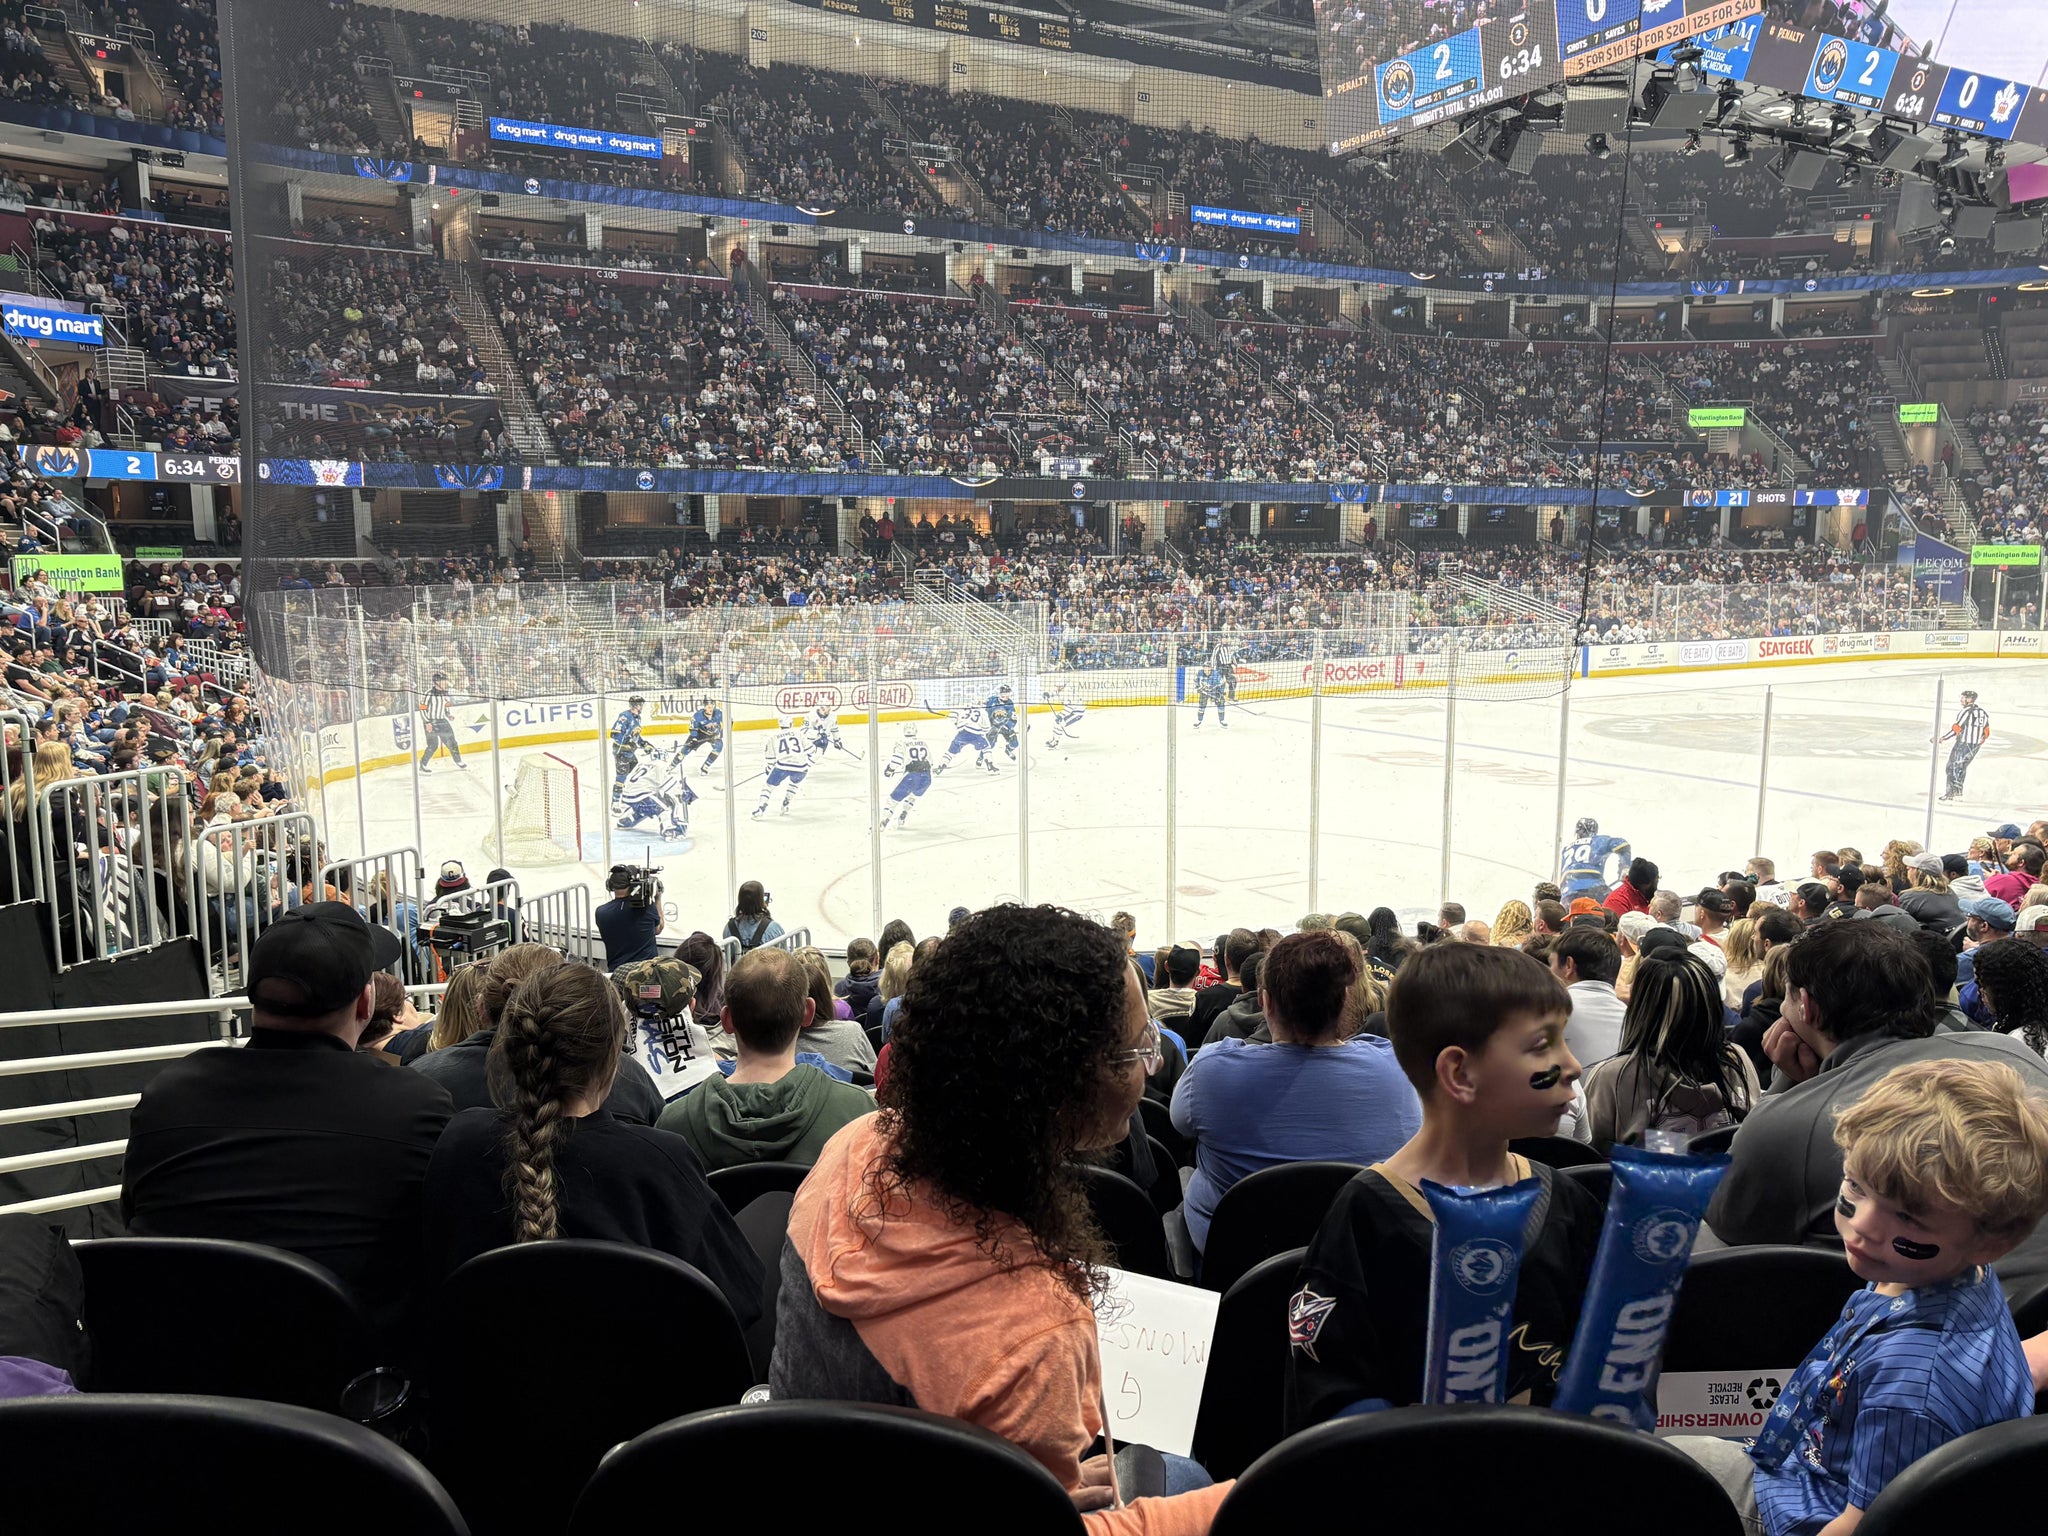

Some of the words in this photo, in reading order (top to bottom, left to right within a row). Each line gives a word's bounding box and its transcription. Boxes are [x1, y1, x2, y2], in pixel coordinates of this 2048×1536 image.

[752, 30, 767, 41] 209
[1566, 39, 1588, 55] SHOTS
[1593, 34, 1600, 44] 7
[1604, 24, 1626, 40] SAVES
[1628, 20, 1639, 32] 19
[1578, 58, 1584, 70] 5
[1587, 51, 1605, 67] FOR
[1606, 46, 1624, 62] $10
[1644, 31, 1664, 47] FOR
[1666, 22, 1686, 39] $20
[1692, 14, 1711, 31] 125
[1712, 7, 1732, 23] FOR
[1777, 27, 1805, 44] PENALTY
[78, 36, 96, 47] 206
[105, 41, 122, 52] 207
[953, 63, 967, 74] 210
[1432, 43, 1453, 80] 2
[1499, 43, 1543, 80] 6:34
[1858, 50, 1880, 86] 2
[399, 79, 414, 89] 207
[446, 86, 461, 95] 208
[1336, 74, 1369, 95] PENALTY
[1958, 74, 1979, 109] 0
[1413, 95, 1432, 108] SHOTS
[1432, 91, 1442, 103] 21
[1469, 79, 1476, 89] 7
[1849, 92, 1857, 102] 21
[1875, 98, 1880, 107] 7
[1411, 105, 1444, 126] TONIGHT'S
[1444, 101, 1466, 117] TOTAL
[1468, 85, 1504, 108] $14,001
[1895, 92, 1925, 116] 6:34
[694, 120, 707, 129] 209
[1954, 115, 1960, 124] 7
[496, 123, 522, 138] drug
[522, 127, 547, 139] mart
[554, 130, 578, 144] drug
[578, 134, 603, 146] mart
[1360, 126, 1387, 143] RAFFLE
[609, 137, 632, 152] drug
[633, 140, 656, 153] mart
[1195, 209, 1211, 220] drug
[1211, 212, 1227, 221] mart
[1231, 213, 1246, 224] drug
[1246, 215, 1262, 224] mart
[1265, 218, 1281, 229] drug
[1281, 221, 1296, 229] mart
[4, 309, 53, 336] drug
[55, 318, 103, 337] mart
[278, 401, 339, 422] THE
[127, 456, 141, 474] 2
[164, 459, 205, 477] 6:34
[208, 456, 238, 466] PERIOD
[221, 465, 231, 476] 2
[1728, 492, 1742, 505] 21
[1757, 493, 1785, 503] SHOTS
[1805, 492, 1814, 505] 7
[1983, 551, 2020, 560] Huntington
[2021, 551, 2038, 559] Bank
[95, 567, 121, 578] Bank
[1758, 638, 1815, 658] SEATGEEK
[1839, 638, 1856, 650] drug
[1856, 638, 1873, 647] mart
[1324, 661, 1386, 682] Rocket
[1078, 680, 1122, 690] MEDICAL
[506, 701, 594, 727] CLIFFS
[778, 737, 802, 755] 43
[1707, 1383, 1743, 1393] RECYCLE
[1709, 1394, 1740, 1405] PLEASE
[1655, 1412, 1764, 1428] OWNERSHIP
